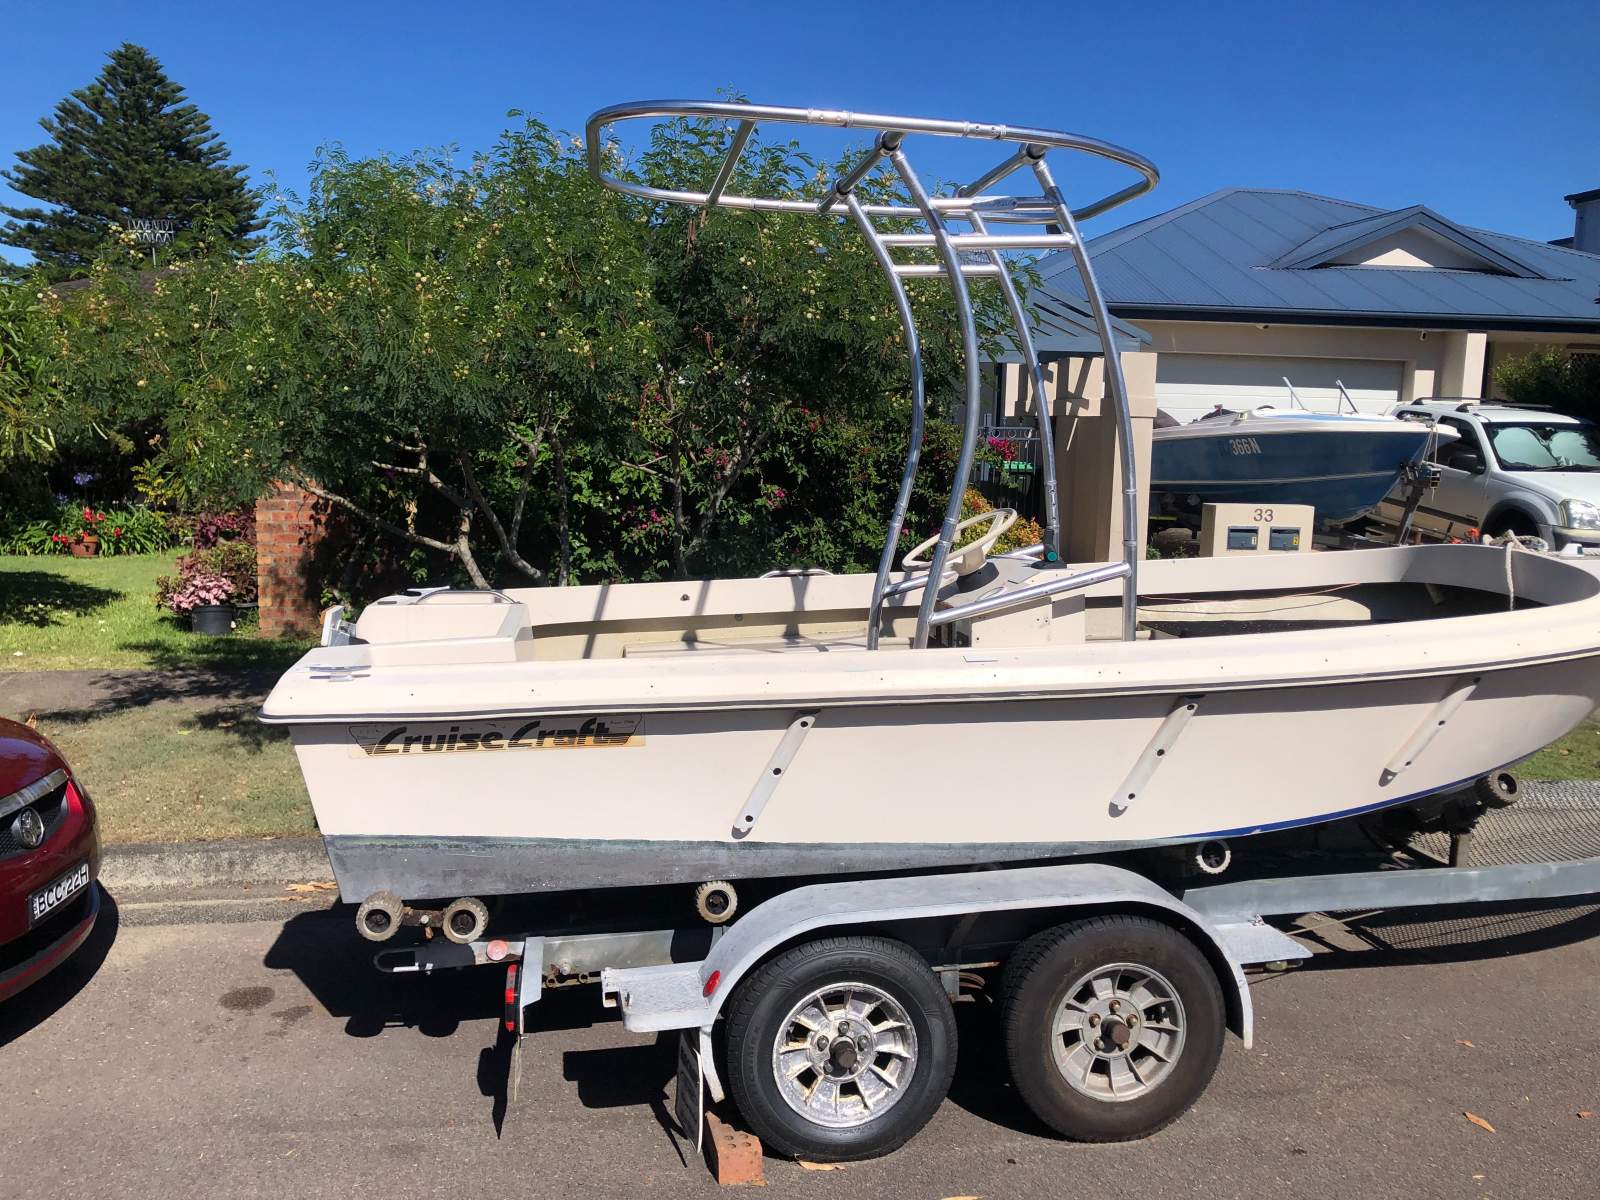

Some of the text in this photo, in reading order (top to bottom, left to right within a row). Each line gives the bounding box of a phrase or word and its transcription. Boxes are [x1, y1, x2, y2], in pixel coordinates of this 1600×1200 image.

[1253, 508, 1274, 522] 33
[375, 717, 614, 754] Cruise Craft
